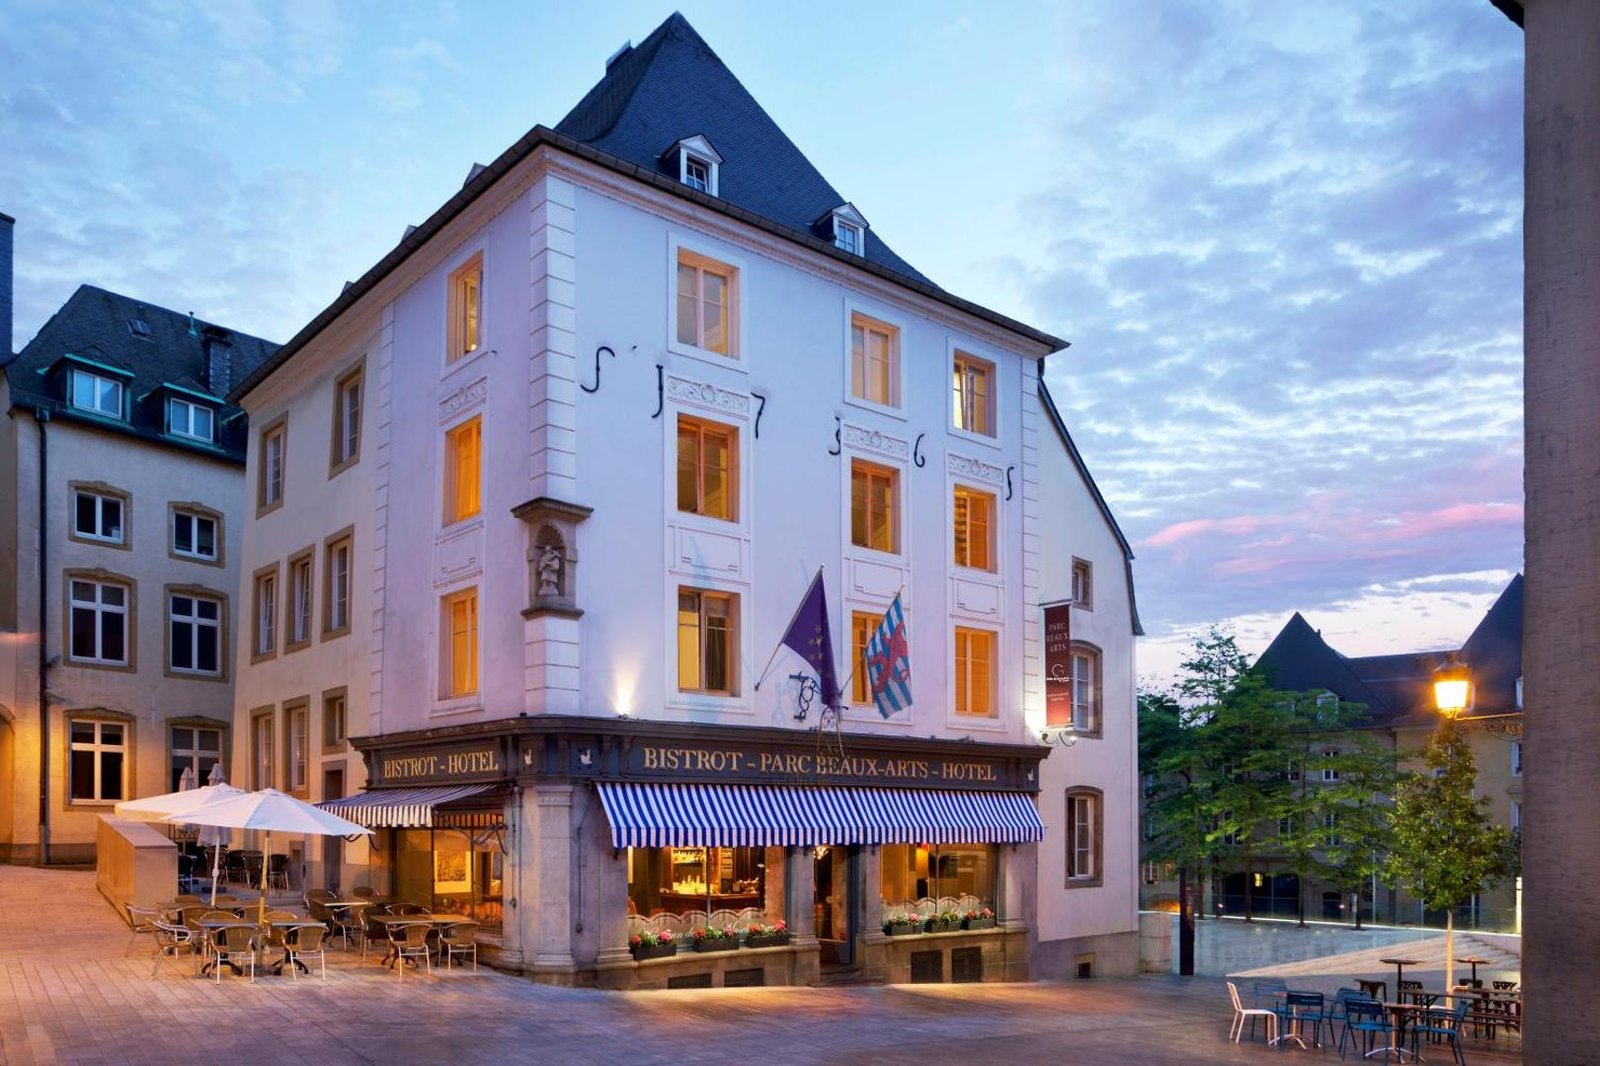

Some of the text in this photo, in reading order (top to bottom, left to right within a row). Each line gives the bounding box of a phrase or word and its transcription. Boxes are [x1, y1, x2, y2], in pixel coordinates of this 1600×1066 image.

[1049, 623, 1066, 631] PARC
[384, 756, 437, 778] BISTROT
[449, 751, 498, 774] HOTEL
[643, 747, 743, 771] BISTROT
[760, 754, 811, 773] PARC
[816, 756, 928, 778] BEAUX-ARTS
[942, 763, 996, 781] HOTEL
